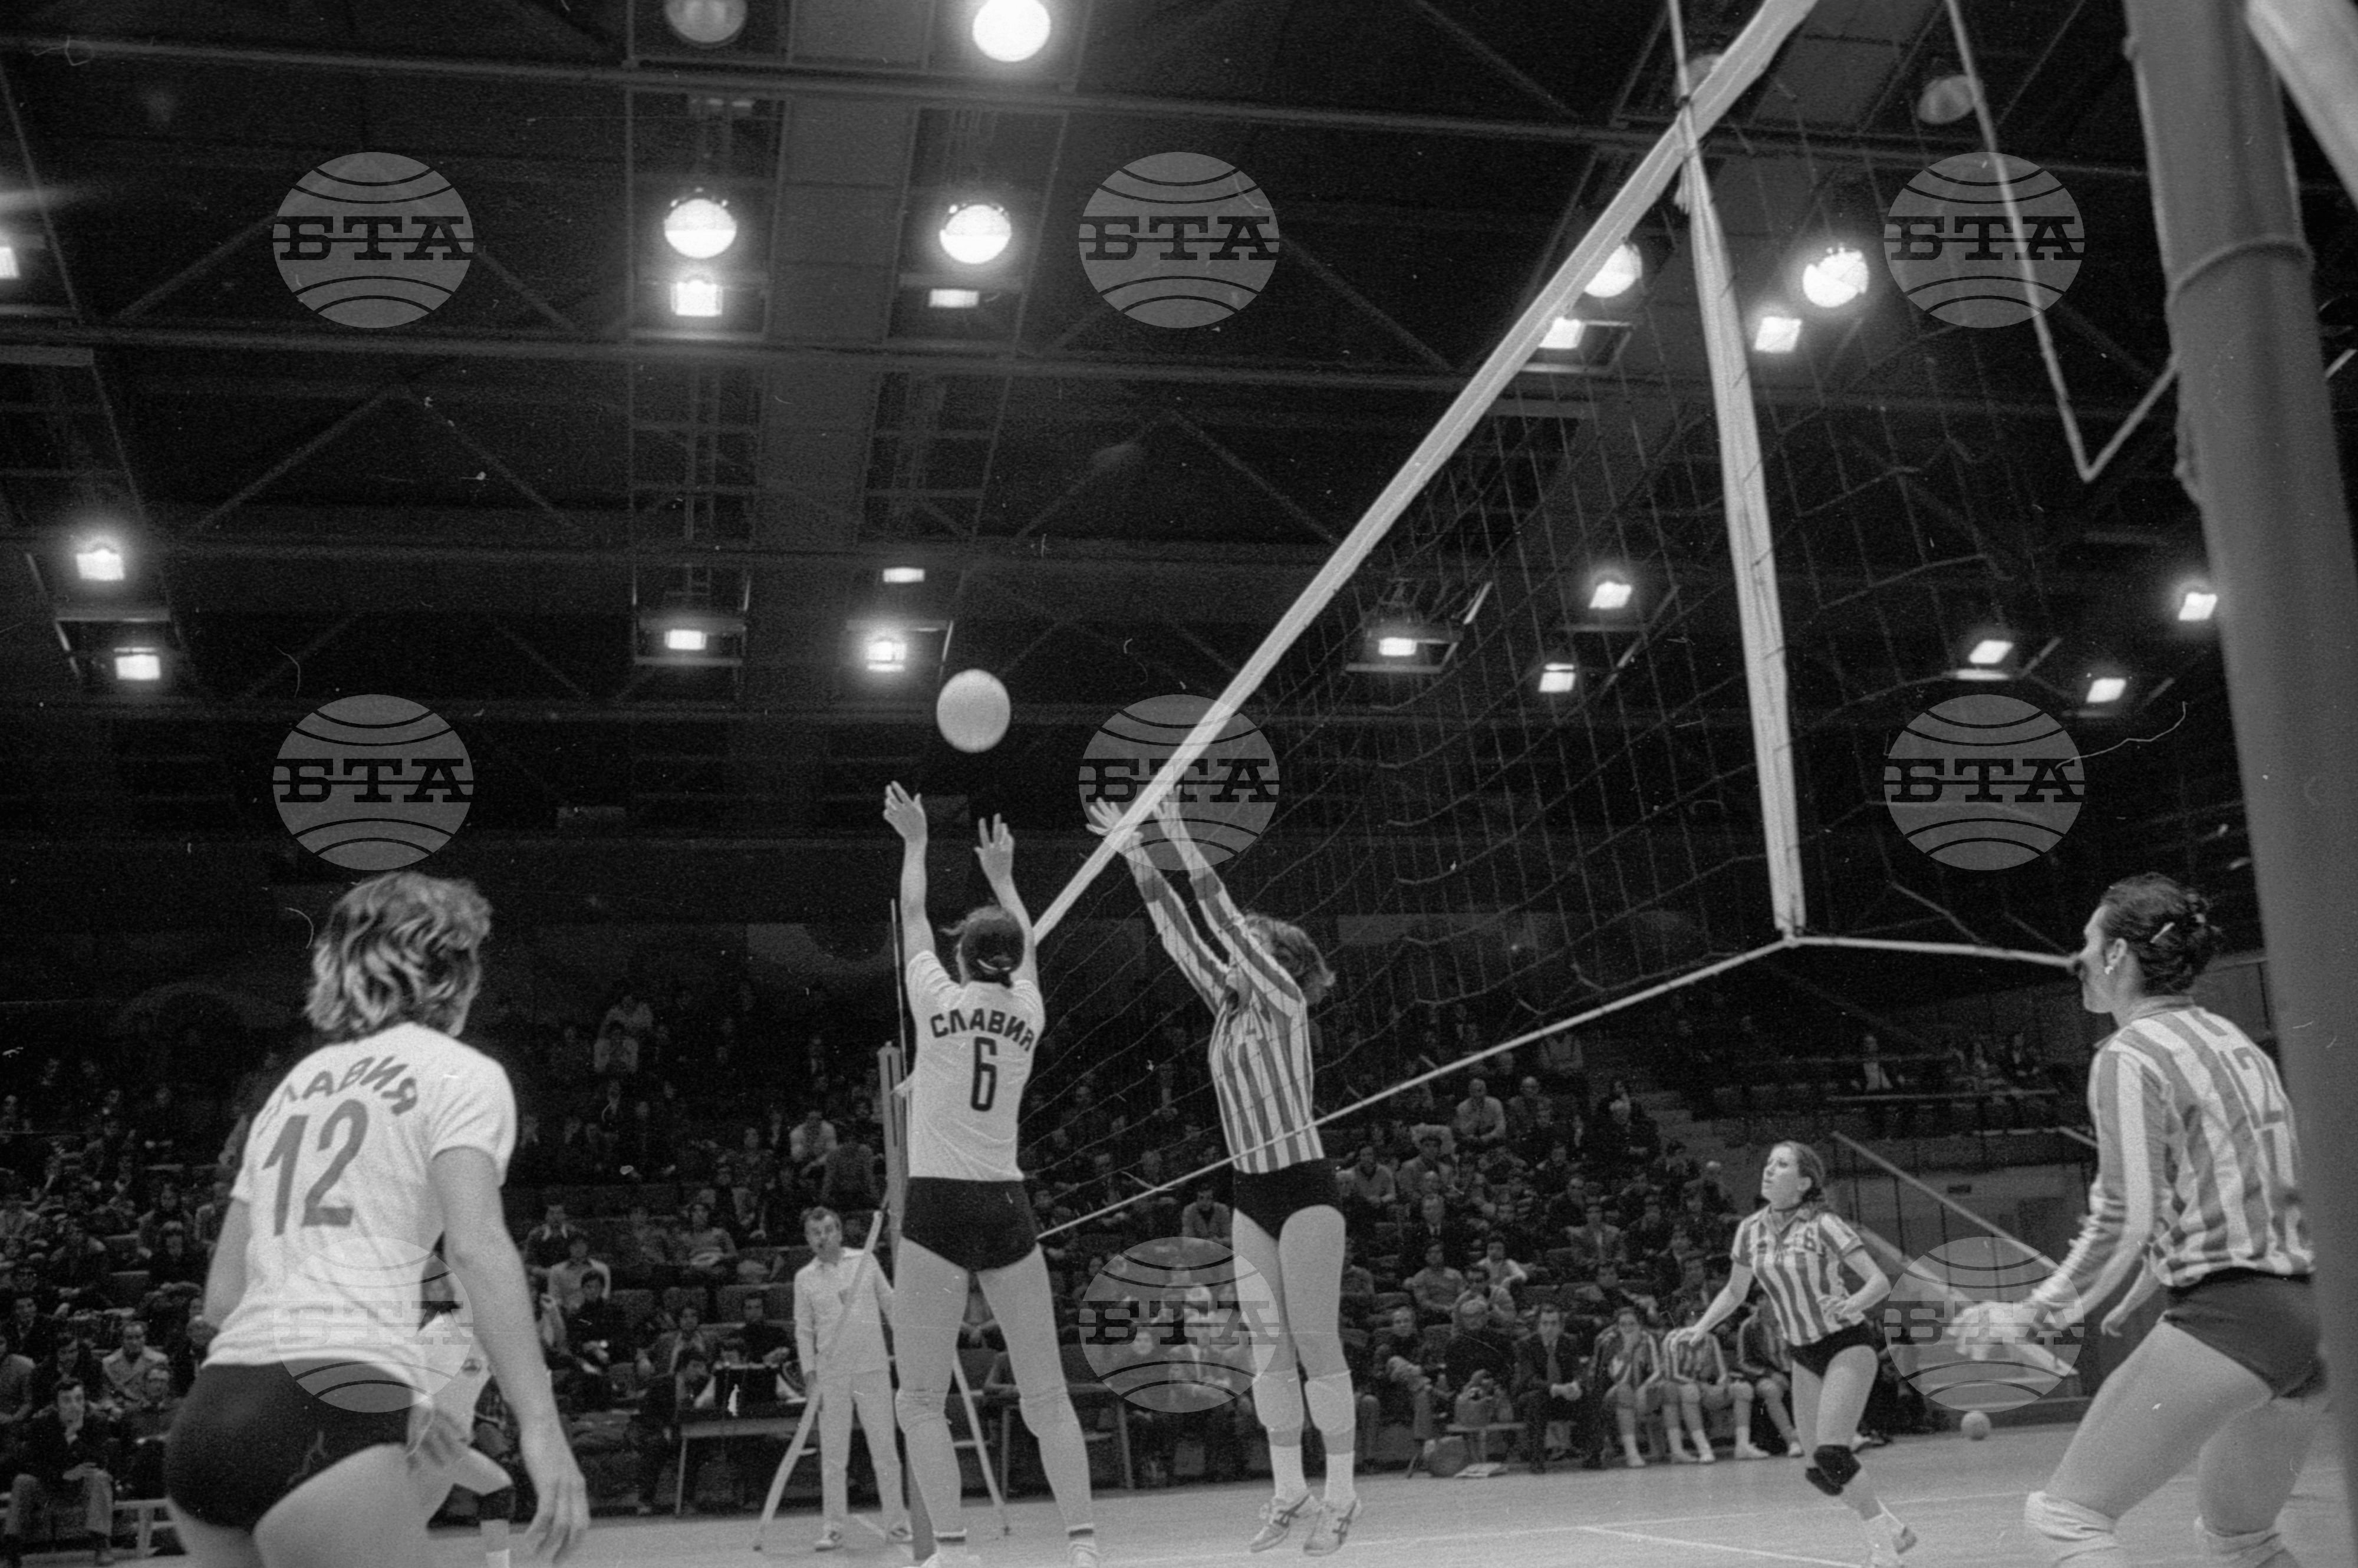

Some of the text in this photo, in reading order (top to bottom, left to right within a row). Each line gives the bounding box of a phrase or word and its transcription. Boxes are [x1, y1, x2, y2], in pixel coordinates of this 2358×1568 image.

[930, 1008, 1035, 1052] СЛАВИЯ
[971, 1036, 997, 1112] 6
[262, 1099, 369, 1237] 12
